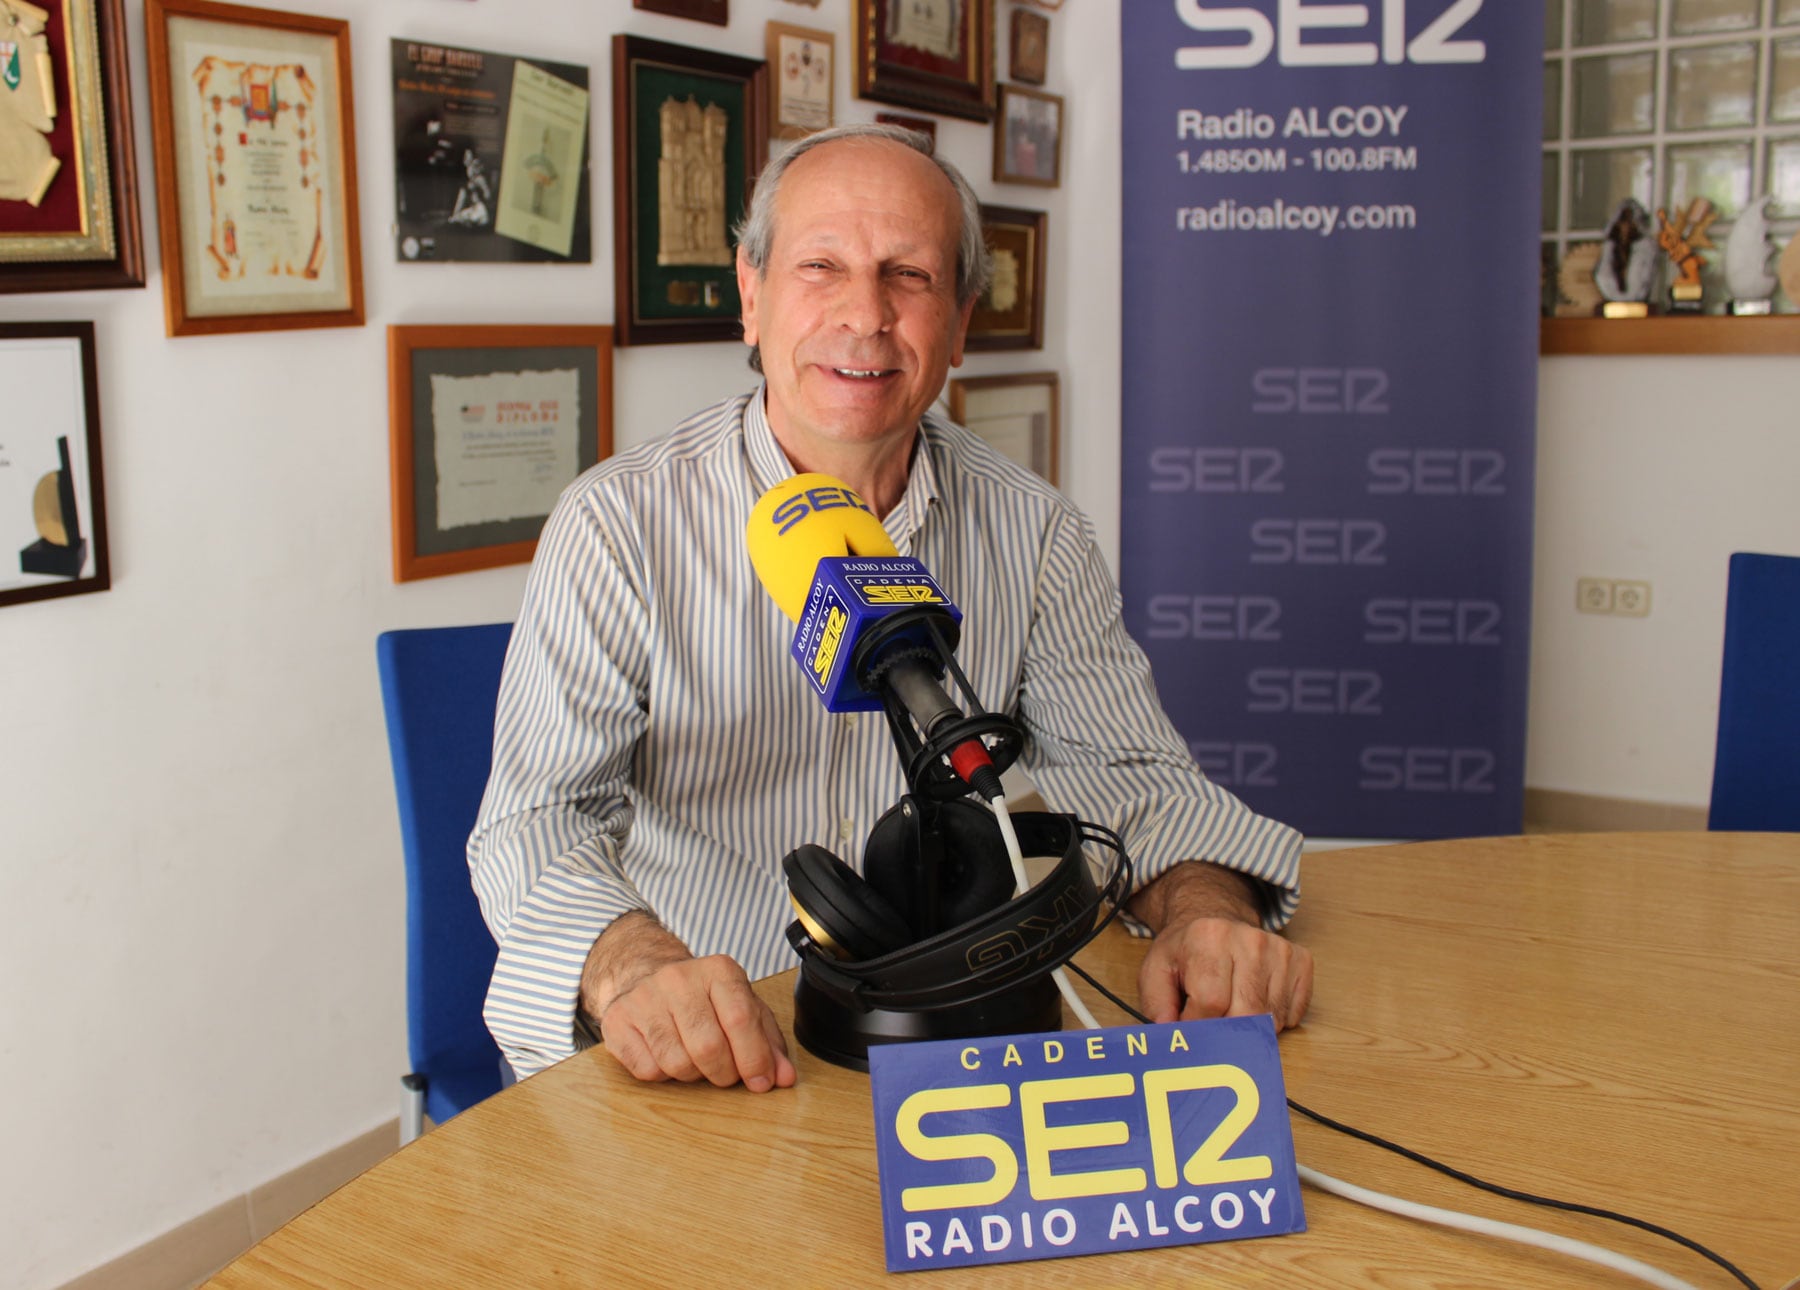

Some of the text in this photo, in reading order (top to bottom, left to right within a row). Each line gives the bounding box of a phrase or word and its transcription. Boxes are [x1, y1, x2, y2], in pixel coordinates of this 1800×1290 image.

[1176, 105, 1408, 140] Radio ALCOY
[1310, 147, 1418, 172] 100.8FM
[1176, 199, 1417, 236] radioalcoy.com
[1251, 367, 1390, 413] SER
[1148, 447, 1506, 495] SER SER
[1249, 520, 1387, 565] SER
[842, 563, 918, 572] RADIO ALCOY
[797, 578, 824, 653] RADIO ALCOY
[862, 585, 943, 603] SER
[807, 595, 834, 666] CADENA
[1147, 595, 1501, 645] SER SER
[813, 606, 847, 686] SER
[1247, 668, 1382, 715] SER
[1189, 741, 1496, 793] ER SER
[960, 1029, 1190, 1071] CADENA
[895, 1063, 1273, 1212] SER
[905, 1187, 1276, 1259] RADIO ALCOY
